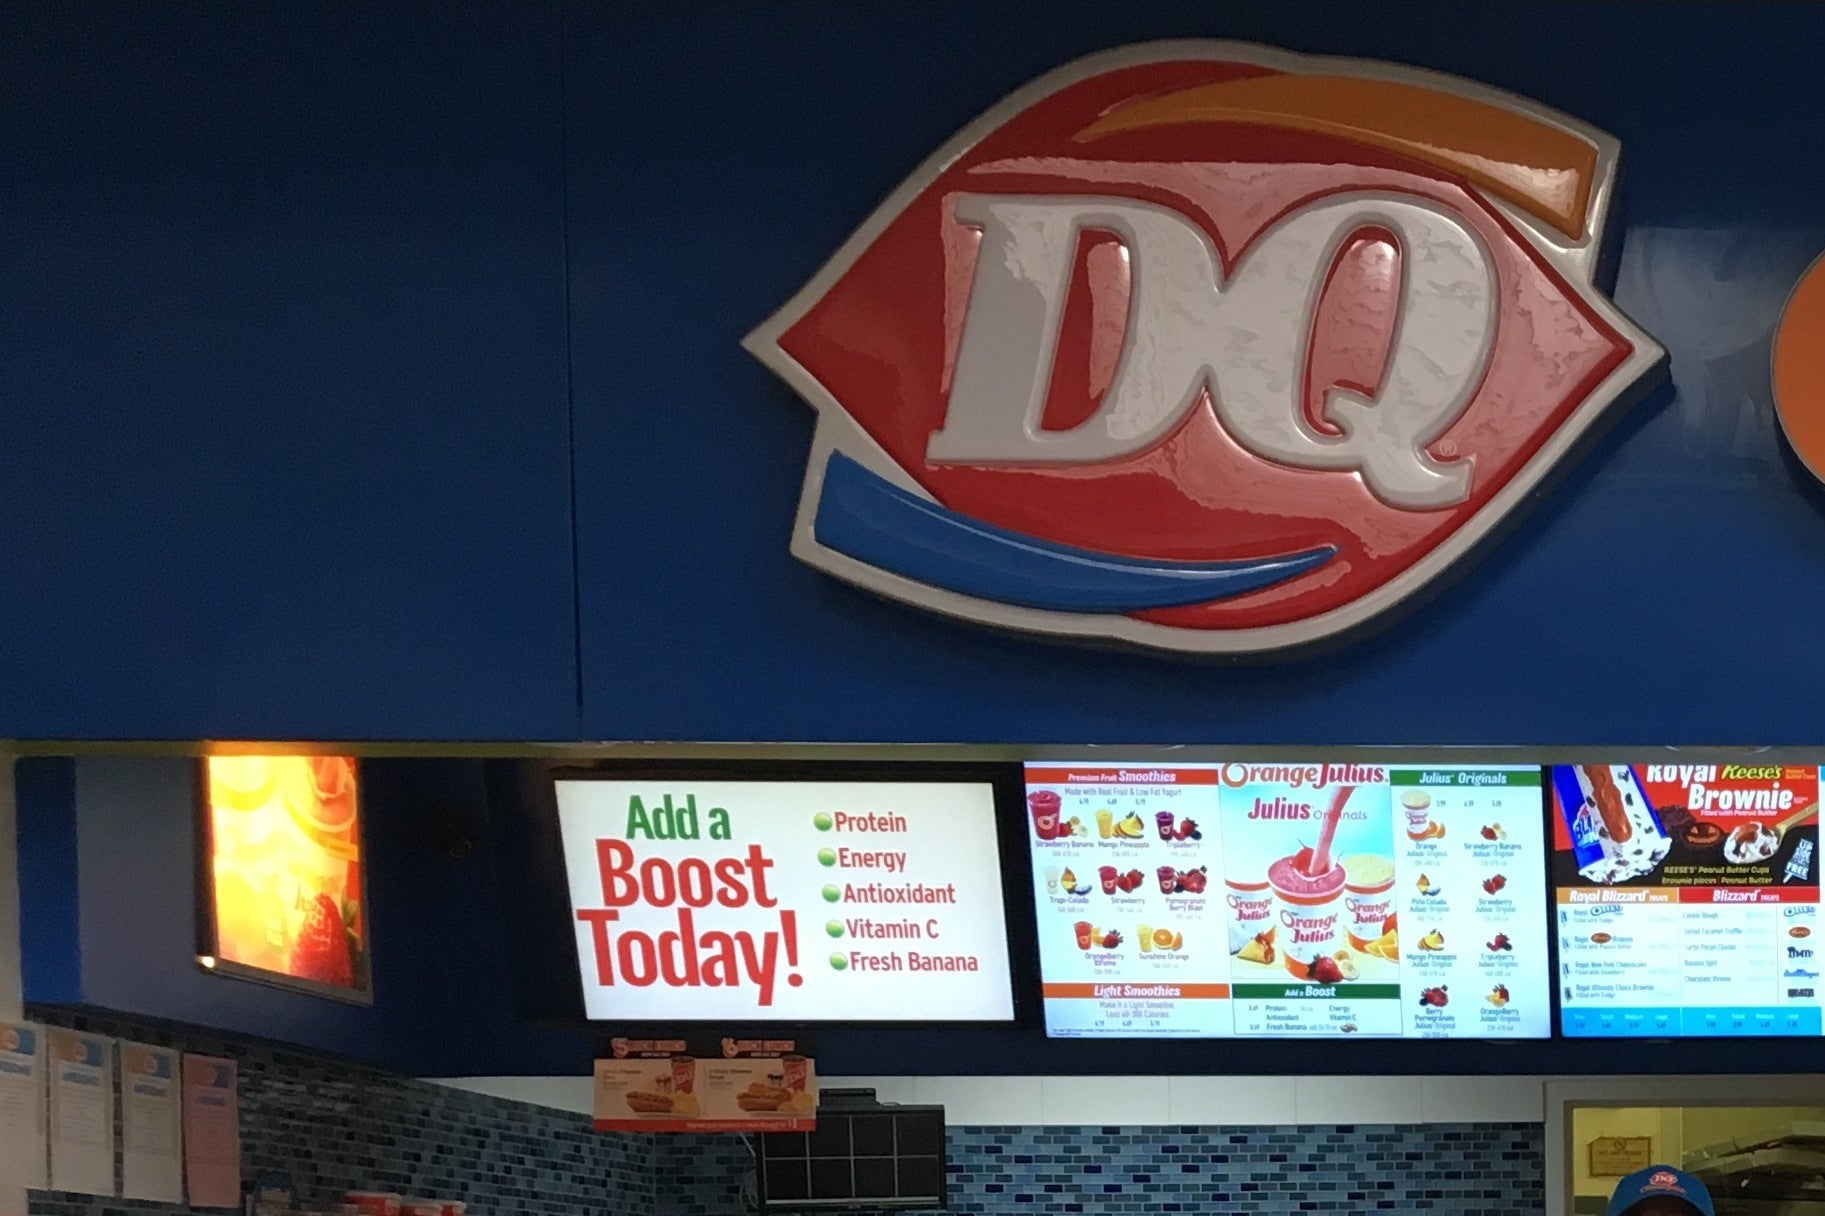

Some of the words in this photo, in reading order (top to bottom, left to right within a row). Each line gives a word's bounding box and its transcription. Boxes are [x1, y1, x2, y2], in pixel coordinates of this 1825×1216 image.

[925, 190, 1477, 511] DQ
[1119, 770, 1176, 783] Smoothies
[1458, 773, 1507, 785] Originals
[1688, 783, 1793, 810] Brownie
[626, 794, 699, 840] Add
[709, 808, 731, 840] a
[1248, 797, 1310, 819] Julius
[835, 812, 906, 832] Protein
[839, 848, 906, 872] Energy
[595, 838, 778, 908] Boost
[844, 882, 956, 904] Antioxidant
[1570, 890, 1600, 903] Royal
[1602, 890, 1647, 902] Blizzard
[1713, 889, 1758, 901] Blizzard
[846, 918, 921, 939] Vitamin
[926, 919, 939, 939] C
[576, 909, 803, 1006] Today!
[851, 952, 902, 971] Fresh
[908, 952, 978, 971] Banana
[1094, 985, 1121, 998] Light
[1124, 985, 1181, 997] Smoothies
[1305, 986, 1336, 997] Boost
